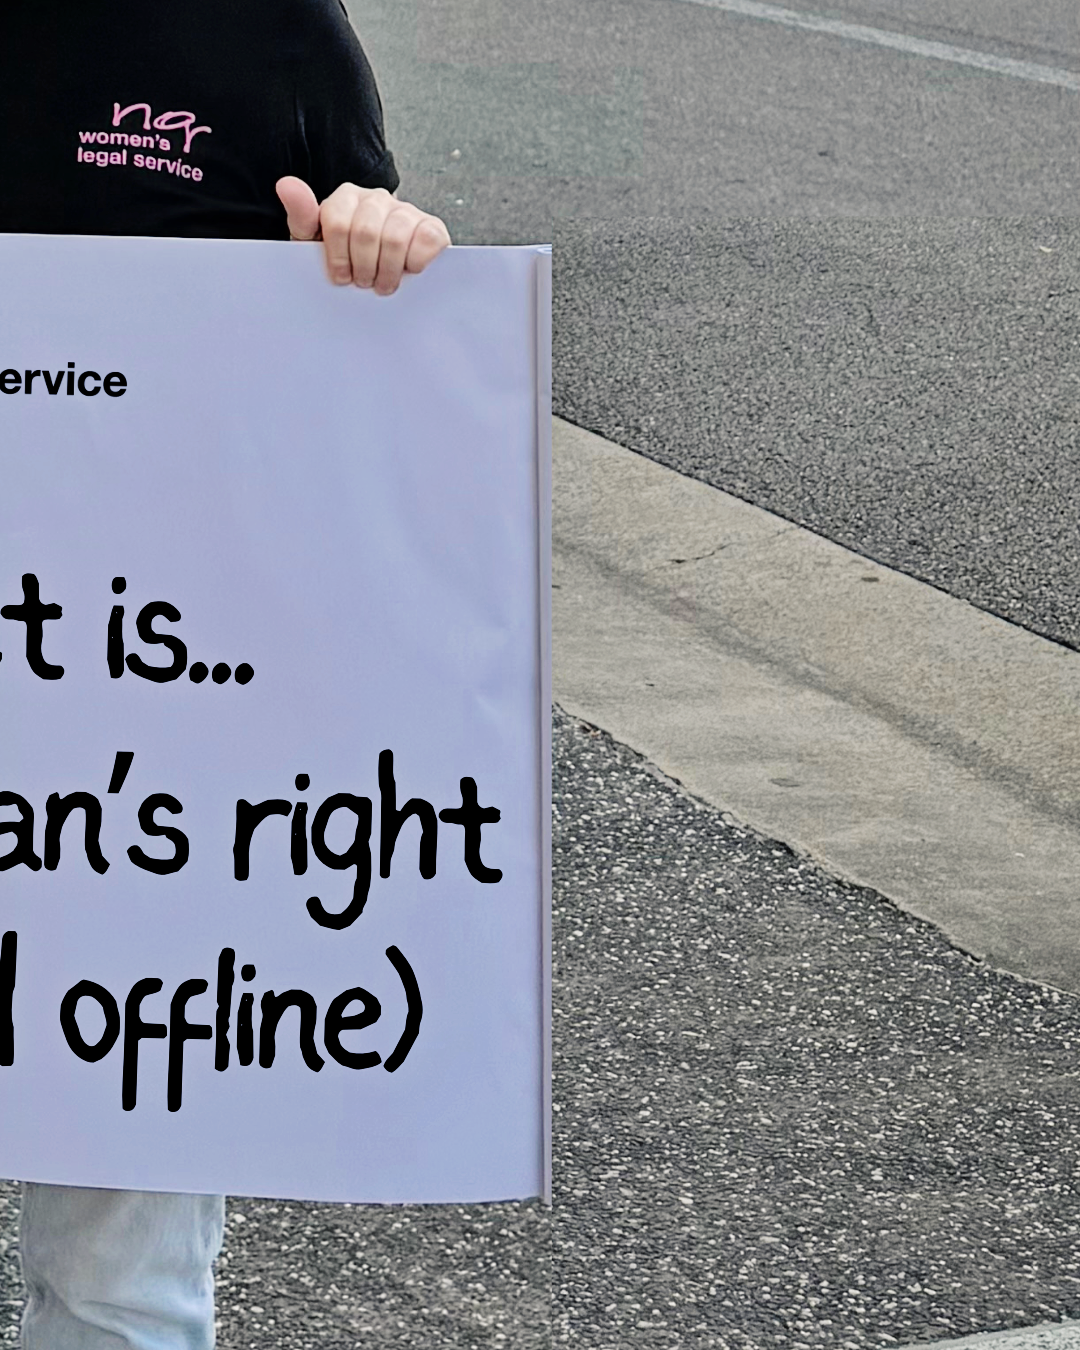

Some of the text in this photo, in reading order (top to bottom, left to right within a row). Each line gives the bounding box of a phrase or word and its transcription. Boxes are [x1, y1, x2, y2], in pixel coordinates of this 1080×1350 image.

[77, 146, 204, 182] legal service
[78, 130, 171, 151] women's
[106, 576, 255, 686] is...
[232, 748, 503, 931] right
[59, 944, 424, 1113] offline)
